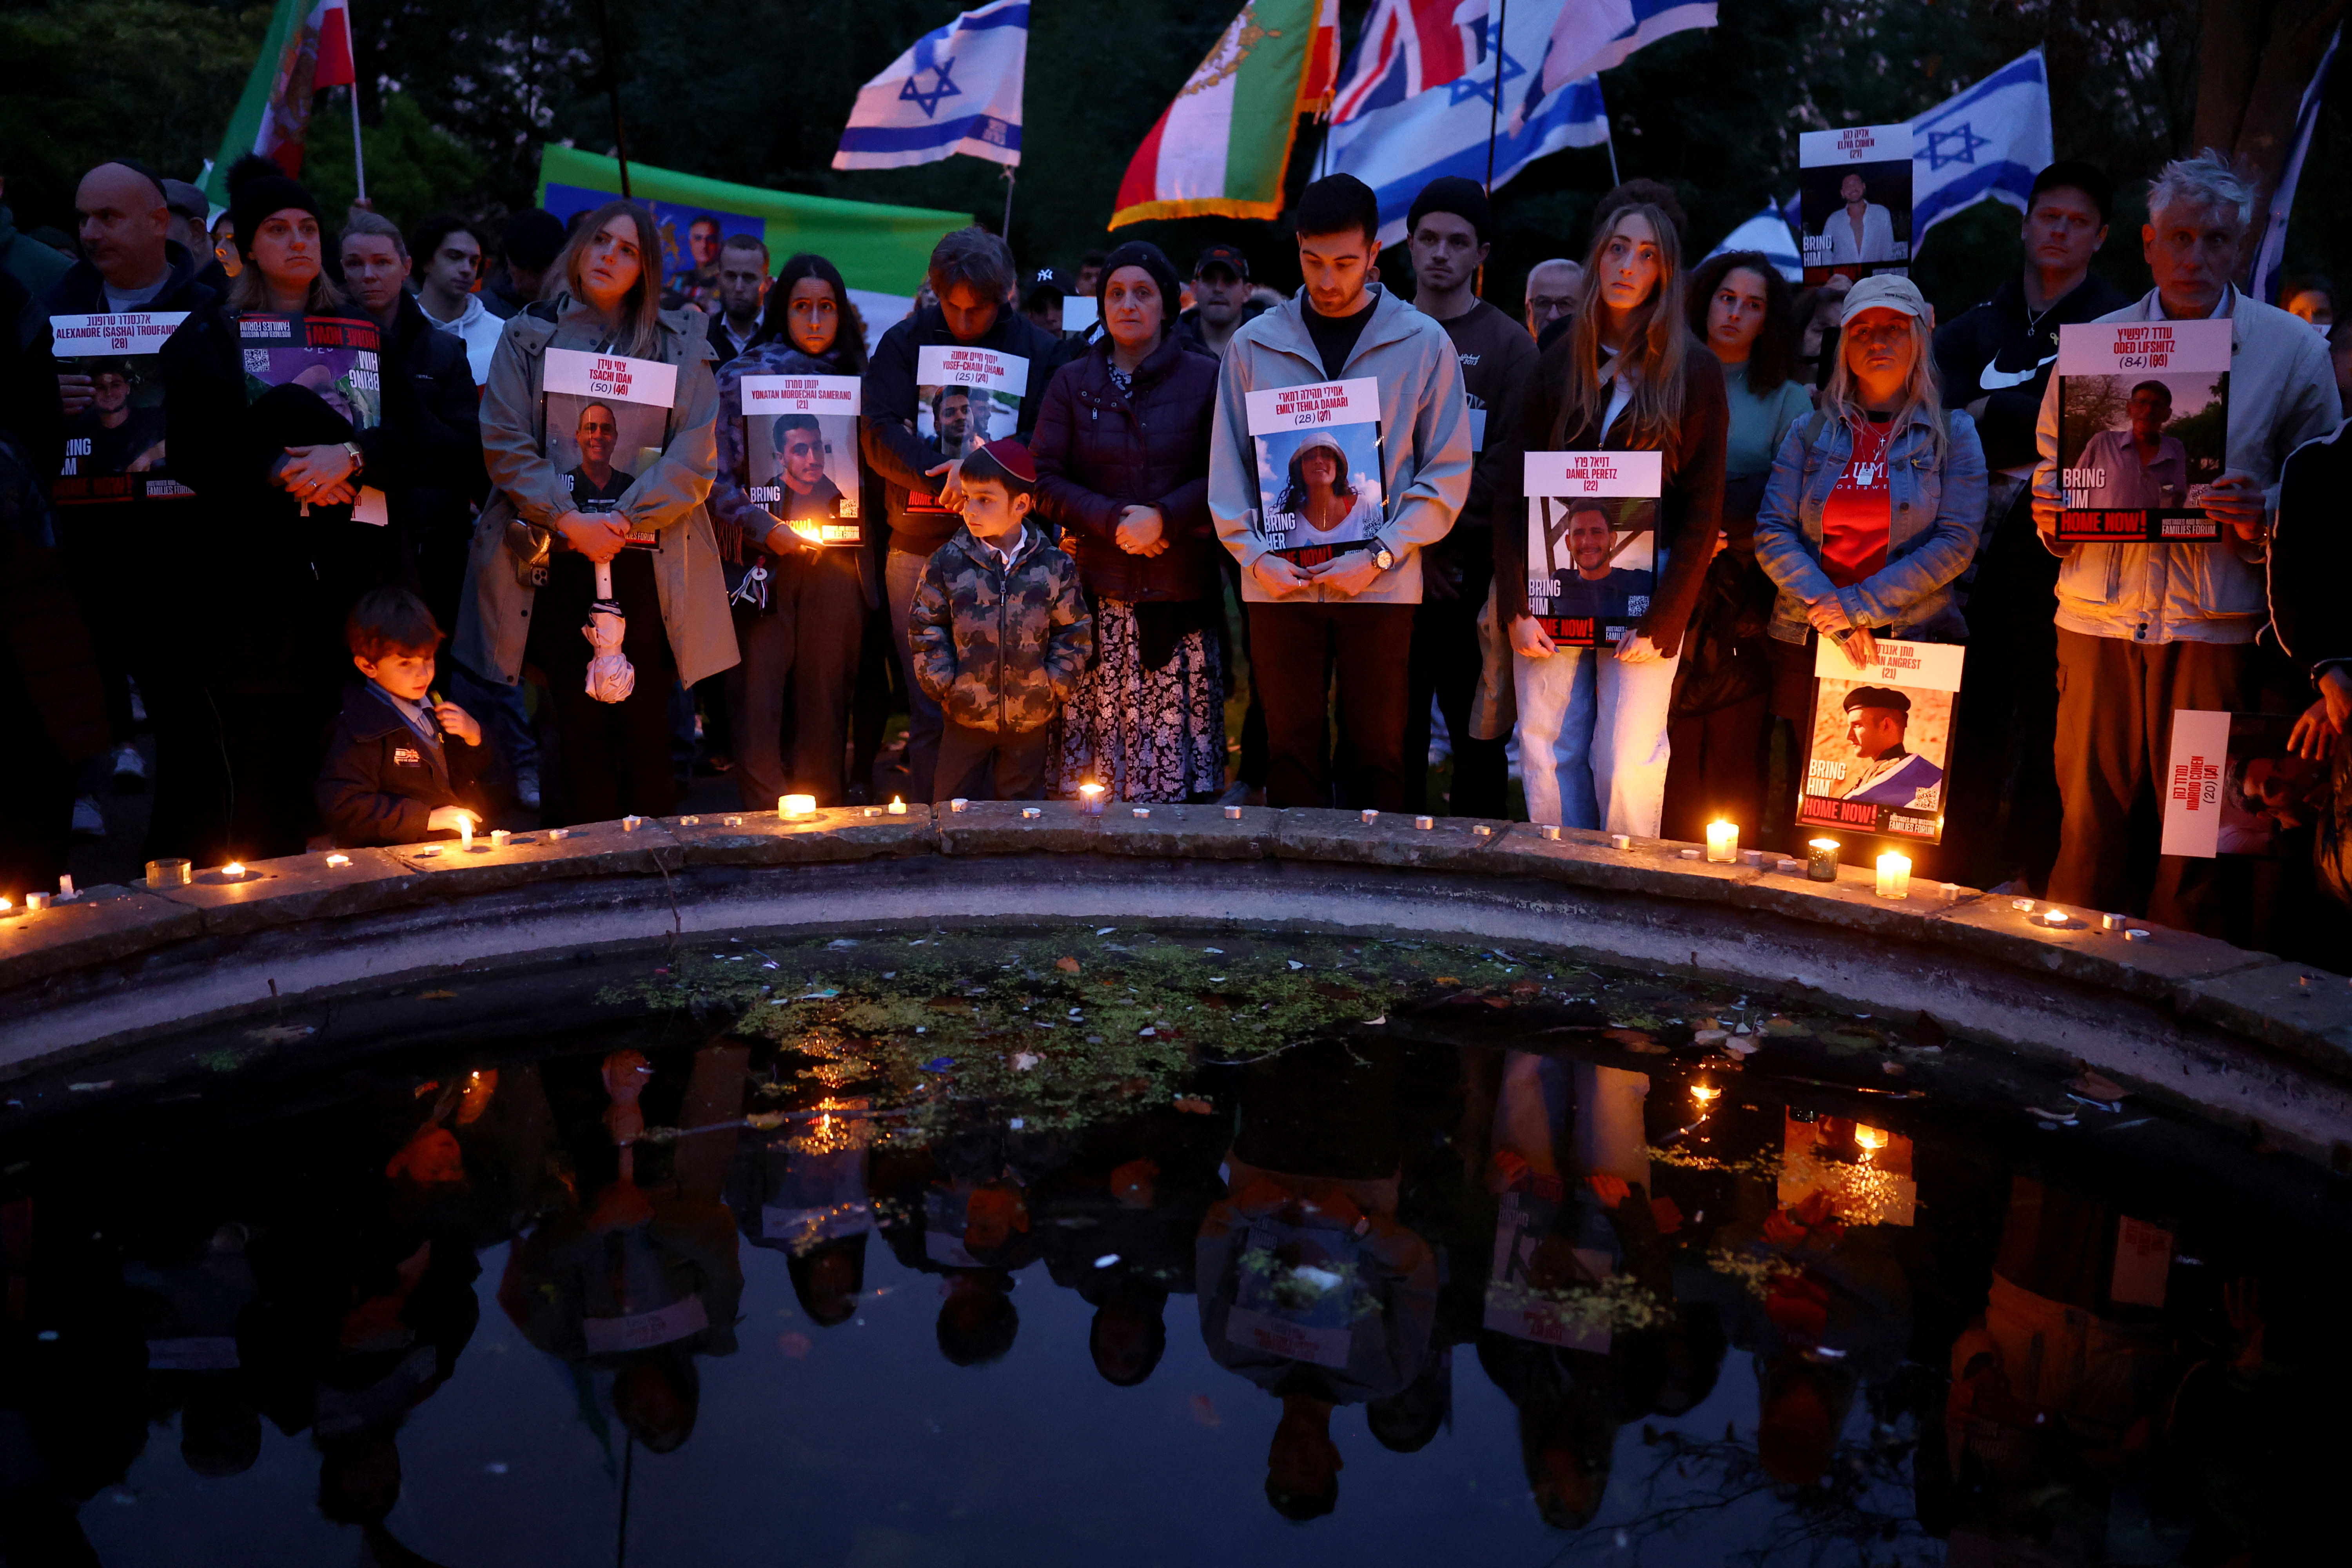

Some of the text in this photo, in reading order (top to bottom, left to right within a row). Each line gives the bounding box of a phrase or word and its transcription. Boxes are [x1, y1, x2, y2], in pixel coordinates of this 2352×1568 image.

[1843, 129, 1869, 140] אליה כהן
[1838, 138, 1875, 149] ELIYA COHEN
[1850, 149, 1862, 159] (27)
[1804, 251, 1822, 267] HIM
[87, 314, 151, 326] אלכסנדר טרופנוב
[240, 321, 290, 331] FAMILIES FORUM
[56, 325, 179, 339] ALEXANDRE (SASHA) TROUFANO
[2118, 327, 2172, 342] עודד ליפשיץ
[112, 338, 128, 349] (28)
[2114, 340, 2175, 354] ODED LIFSHITZ
[358, 350, 378, 371] HIM
[951, 351, 998, 364] יוסף חיים אוחנה
[2120, 356, 2147, 369] (84)
[598, 359, 626, 372] צחי עידן
[943, 361, 1004, 376] YOSEF-CHAIM OHANA
[349, 369, 380, 392] BRING
[590, 369, 632, 384] TSACHI IDAN
[956, 372, 974, 382] (25)
[591, 382, 612, 394] (50)
[785, 379, 818, 389] יונתן סמרנו
[752, 390, 851, 400] YONATAN MORDECHAI SAMERANO
[1278, 386, 1343, 403] אמילי תהילה דמארי
[797, 399, 808, 410] (21)
[1276, 397, 1348, 415] EMILY TEHILA DAMARI
[1295, 413, 1316, 425] (28)
[66, 437, 91, 456] ING
[1575, 456, 1610, 468] דניאל פרץ
[1566, 468, 1617, 479] DANIEL PERETZ
[2063, 468, 2106, 488] BRING
[146, 486, 173, 496] FAMILIES
[1584, 479, 1598, 492] (22)
[750, 486, 780, 502] BRING
[2062, 489, 2089, 509] HIM
[1265, 512, 1296, 532] BRING
[2060, 509, 2147, 533] HOME NOW!
[2161, 525, 2216, 535] FAMILIES FORUM
[637, 533, 655, 542] FORUM
[1267, 533, 1287, 550] HER
[1528, 579, 1561, 597] BRING
[1528, 597, 1548, 615] HIM
[1560, 617, 1594, 637] NOW!
[1606, 632, 1626, 641] FAMILI
[1900, 646, 1914, 657] מתן
[1887, 657, 1922, 670] ANGREST
[1882, 667, 1896, 680] (21)
[1809, 759, 1846, 780] BRING
[1806, 777, 1831, 797] HIM
[2173, 765, 2188, 799] נמרוד כהן
[2186, 756, 2204, 810] NIMROD COHEN
[2203, 781, 2218, 804] (20)
[1803, 797, 1877, 825] HOME NOW!
[1889, 814, 1909, 822] HOSTAGES
[1889, 820, 1935, 835] FAMILIES FORUM
